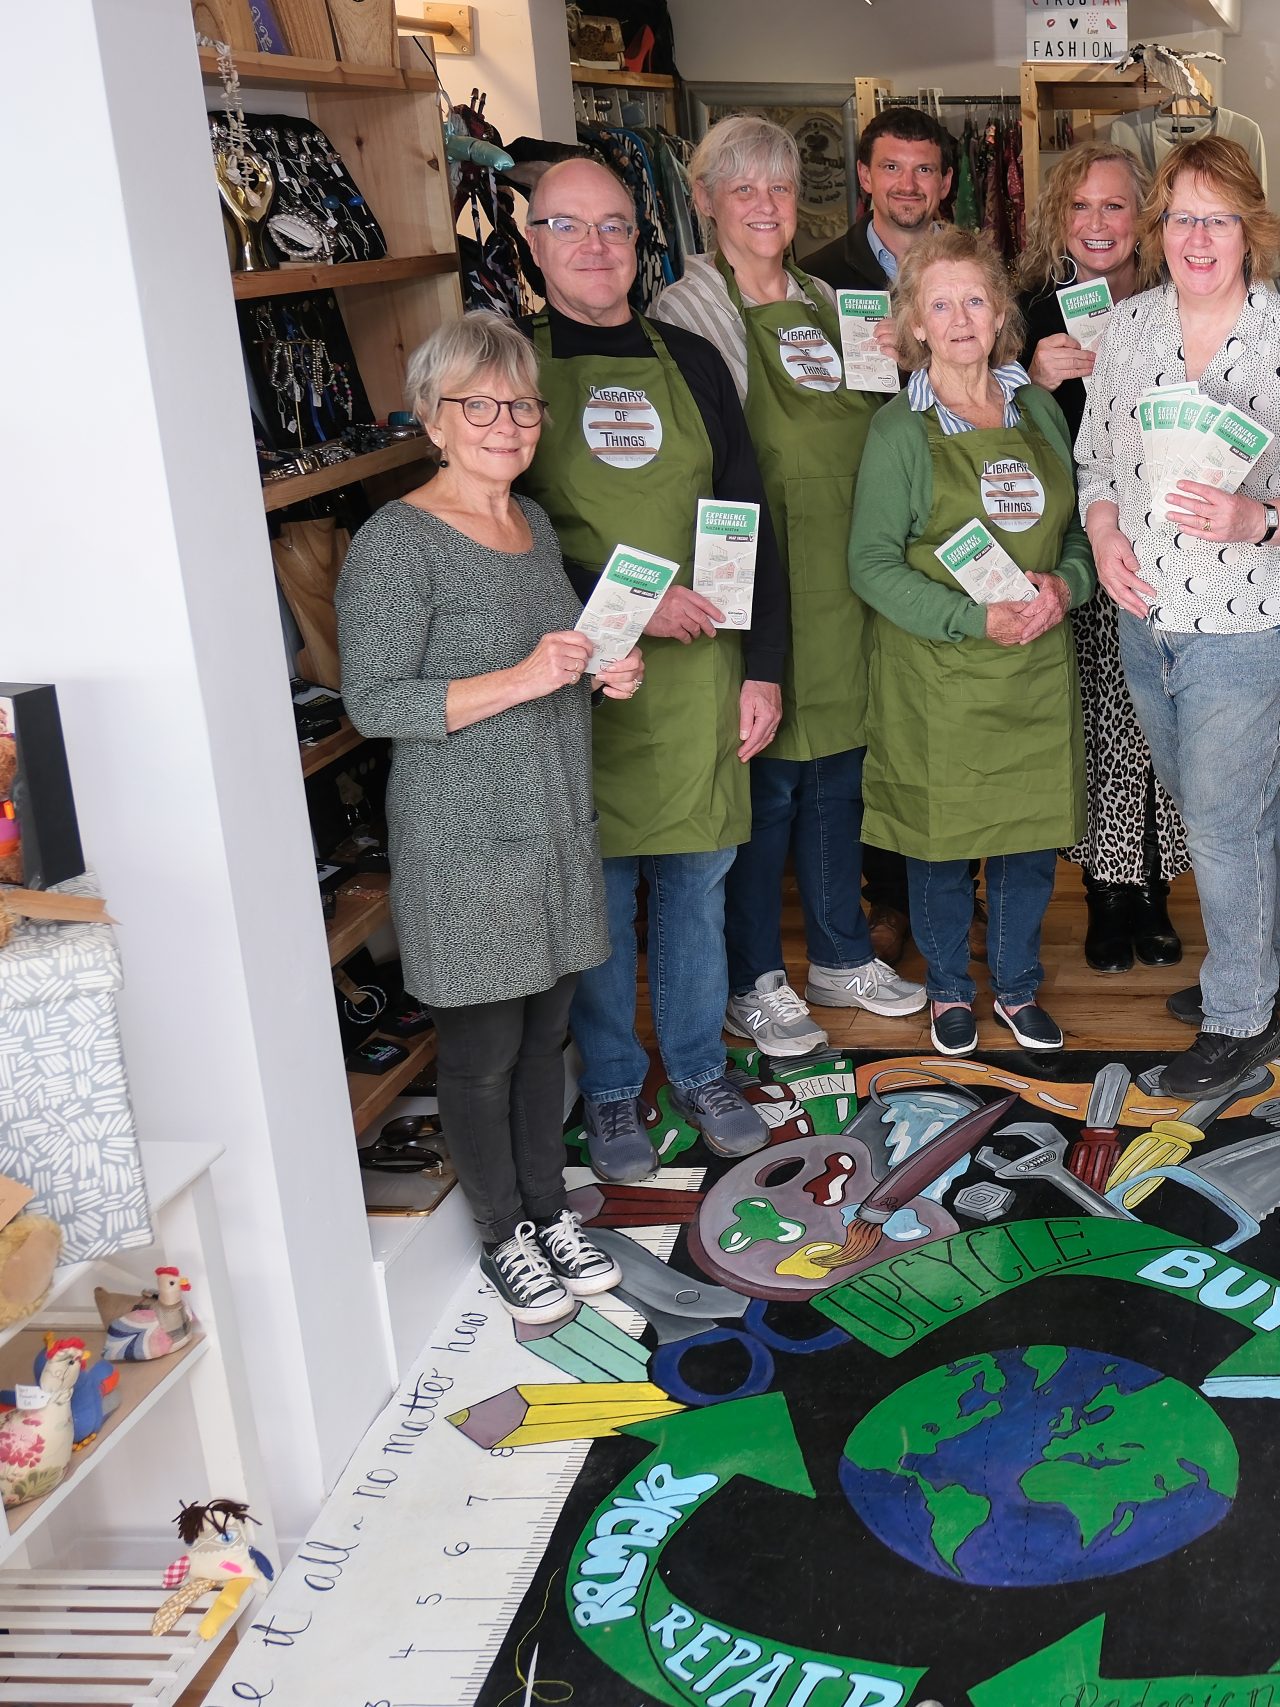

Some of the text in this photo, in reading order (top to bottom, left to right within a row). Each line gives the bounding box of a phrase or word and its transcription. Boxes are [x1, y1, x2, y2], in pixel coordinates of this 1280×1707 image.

[1033, 41, 1112, 57] FASHION
[1067, 296, 1102, 310] SUSTAINABLE
[779, 328, 822, 341] LIBRARY
[797, 364, 831, 376] THINGS
[590, 386, 645, 402] LIBRARY
[614, 410, 628, 421] OF
[1221, 423, 1256, 448] SUSTAINABLE
[1225, 417, 1258, 441] EXPERIENCE
[600, 432, 645, 447] THINGS
[984, 462, 1028, 475] LIBRARY
[1003, 482, 1016, 491] OF
[995, 500, 1032, 512] THINGS
[705, 512, 747, 520] EXPERIENCE
[705, 518, 748, 527] SUSTAINABLE
[615, 566, 660, 584] SUSTAINABLE
[618, 560, 661, 577] EXPERIENCE
[795, 1075, 847, 1099] GREEN
[819, 1219, 1093, 1341] UPCYCLE
[490, 1446, 515, 1458] 8
[251, 1610, 313, 1648] it
[298, 1539, 361, 1592] all
[352, 1468, 398, 1500] no
[382, 1367, 456, 1455] matter
[430, 1311, 488, 1353] how
[466, 1494, 490, 1507] 7
[443, 1541, 471, 1557] 6
[416, 1592, 443, 1606] 5
[389, 1643, 417, 1659] 4
[650, 1603, 906, 1707] REPAIR
